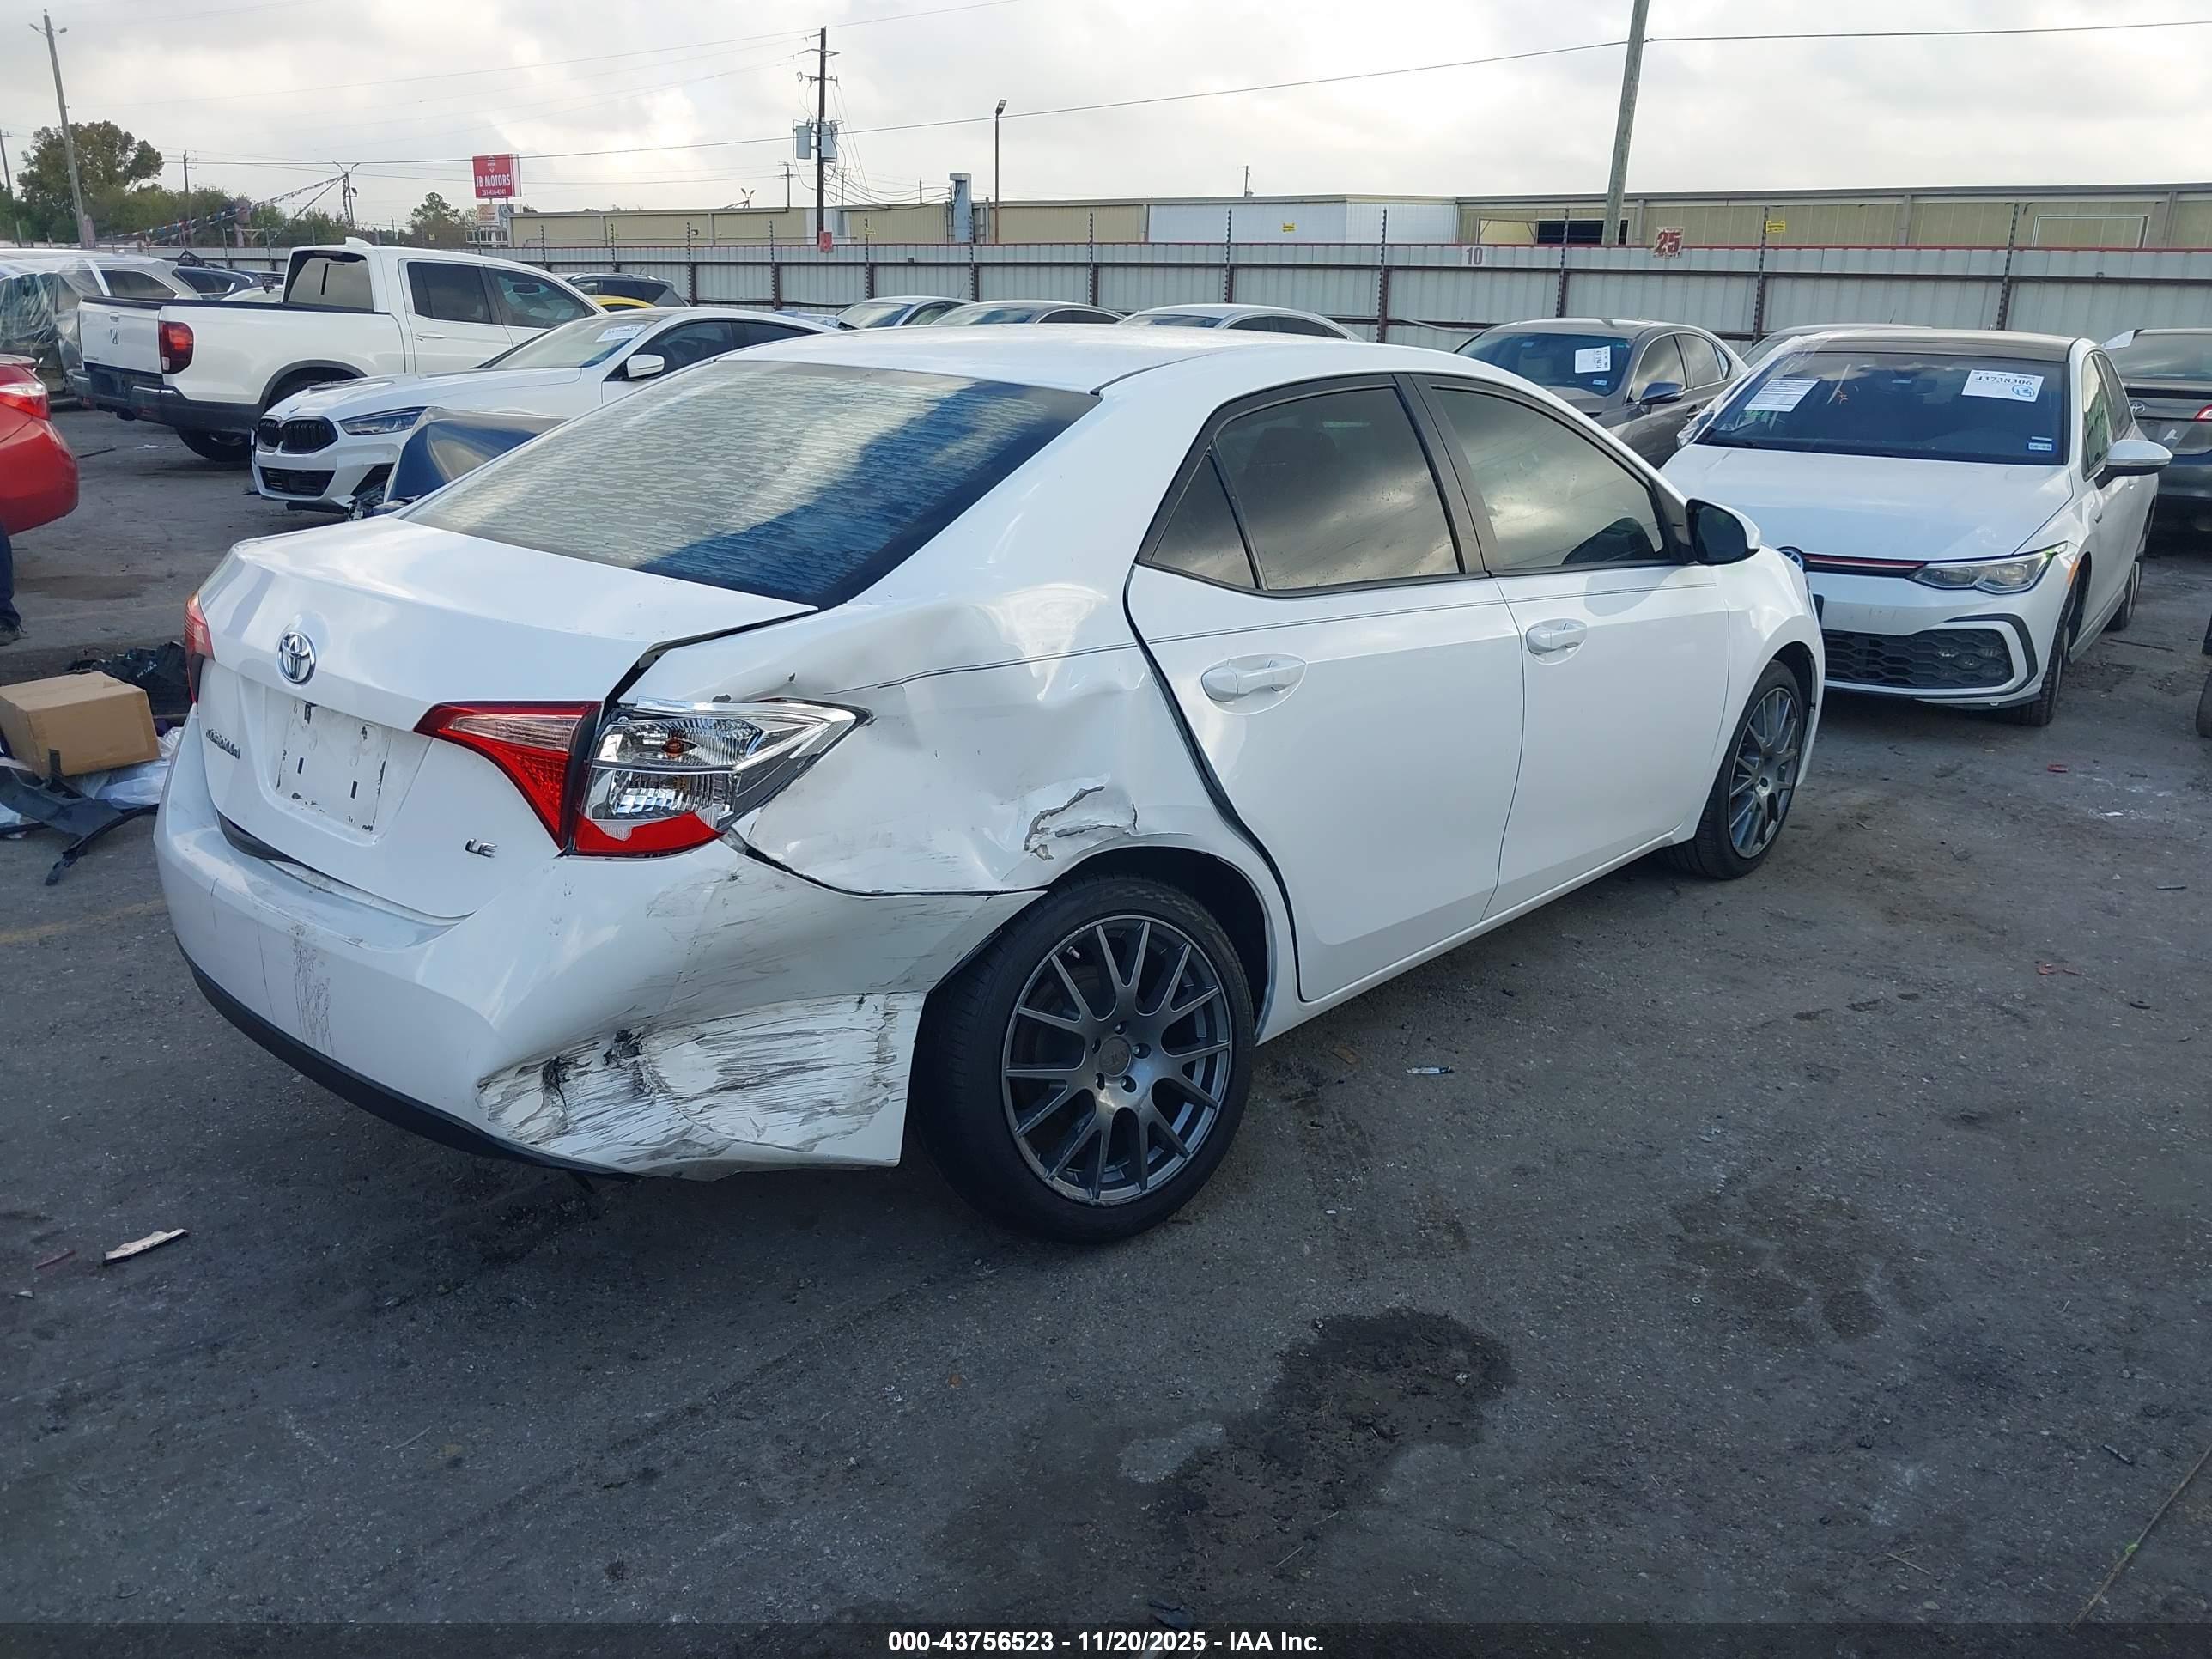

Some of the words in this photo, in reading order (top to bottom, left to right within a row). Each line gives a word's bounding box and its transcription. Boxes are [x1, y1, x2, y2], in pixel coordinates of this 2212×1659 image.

[477, 175, 483, 187] JB
[485, 174, 510, 186] MOTORS
[1654, 231, 1682, 255] 25
[1465, 246, 1483, 265] 10
[465, 838, 498, 858] LE
